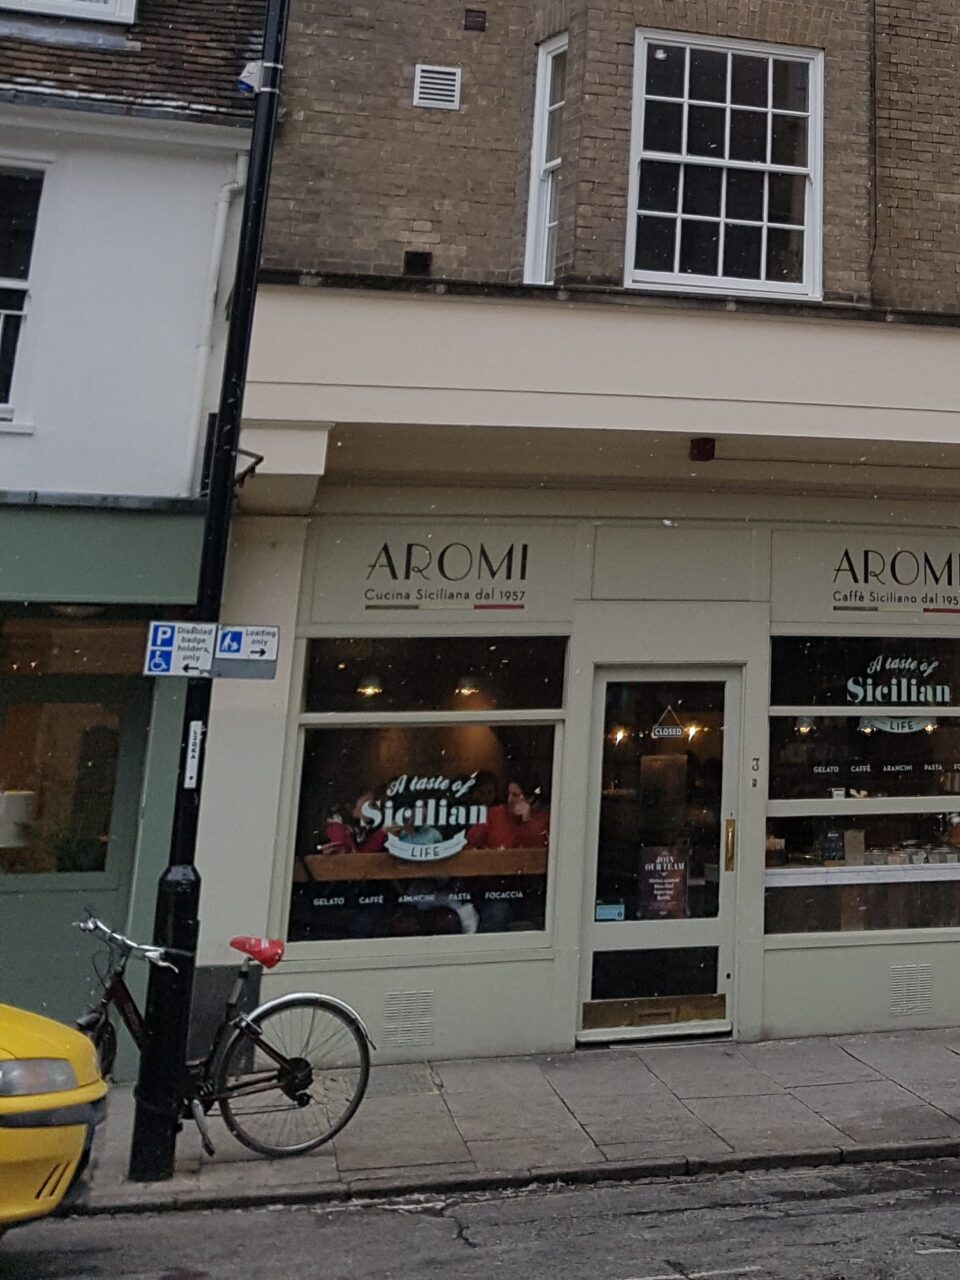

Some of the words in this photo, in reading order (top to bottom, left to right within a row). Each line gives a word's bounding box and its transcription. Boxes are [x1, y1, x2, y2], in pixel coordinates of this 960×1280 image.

[366, 542, 529, 582] AROMI
[364, 588, 411, 600] Cucina
[416, 588, 470, 600] Siciliana
[475, 588, 495, 600] dal
[500, 590, 526, 601] 1957
[833, 590, 865, 602] Caffè
[869, 591, 917, 603] Siciliano
[921, 593, 938, 604] dal
[157, 626, 172, 646] P
[177, 626, 213, 636] Disabled
[245, 629, 276, 639] Loading
[182, 635, 206, 644] badge
[251, 638, 268, 646] only
[177, 645, 209, 653] holders
[183, 653, 200, 662] only
[867, 655, 883, 674] A
[885, 657, 917, 670] taste
[920, 661, 939, 677] of
[847, 677, 951, 703] Sicilian
[654, 727, 682, 736] CLOSED
[889, 720, 914, 731] LIFE
[752, 758, 760, 772] 3
[813, 765, 840, 773] GELATO
[883, 764, 913, 772] ARANCINI
[387, 774, 408, 797] A
[410, 776, 450, 791] taste
[452, 777, 476, 798] of
[360, 798, 489, 828] Sicilian
[411, 846, 441, 858] LIFE
[313, 896, 345, 906] GELATO
[448, 893, 471, 901] PASTA
[485, 890, 524, 900] FOCACCIA
